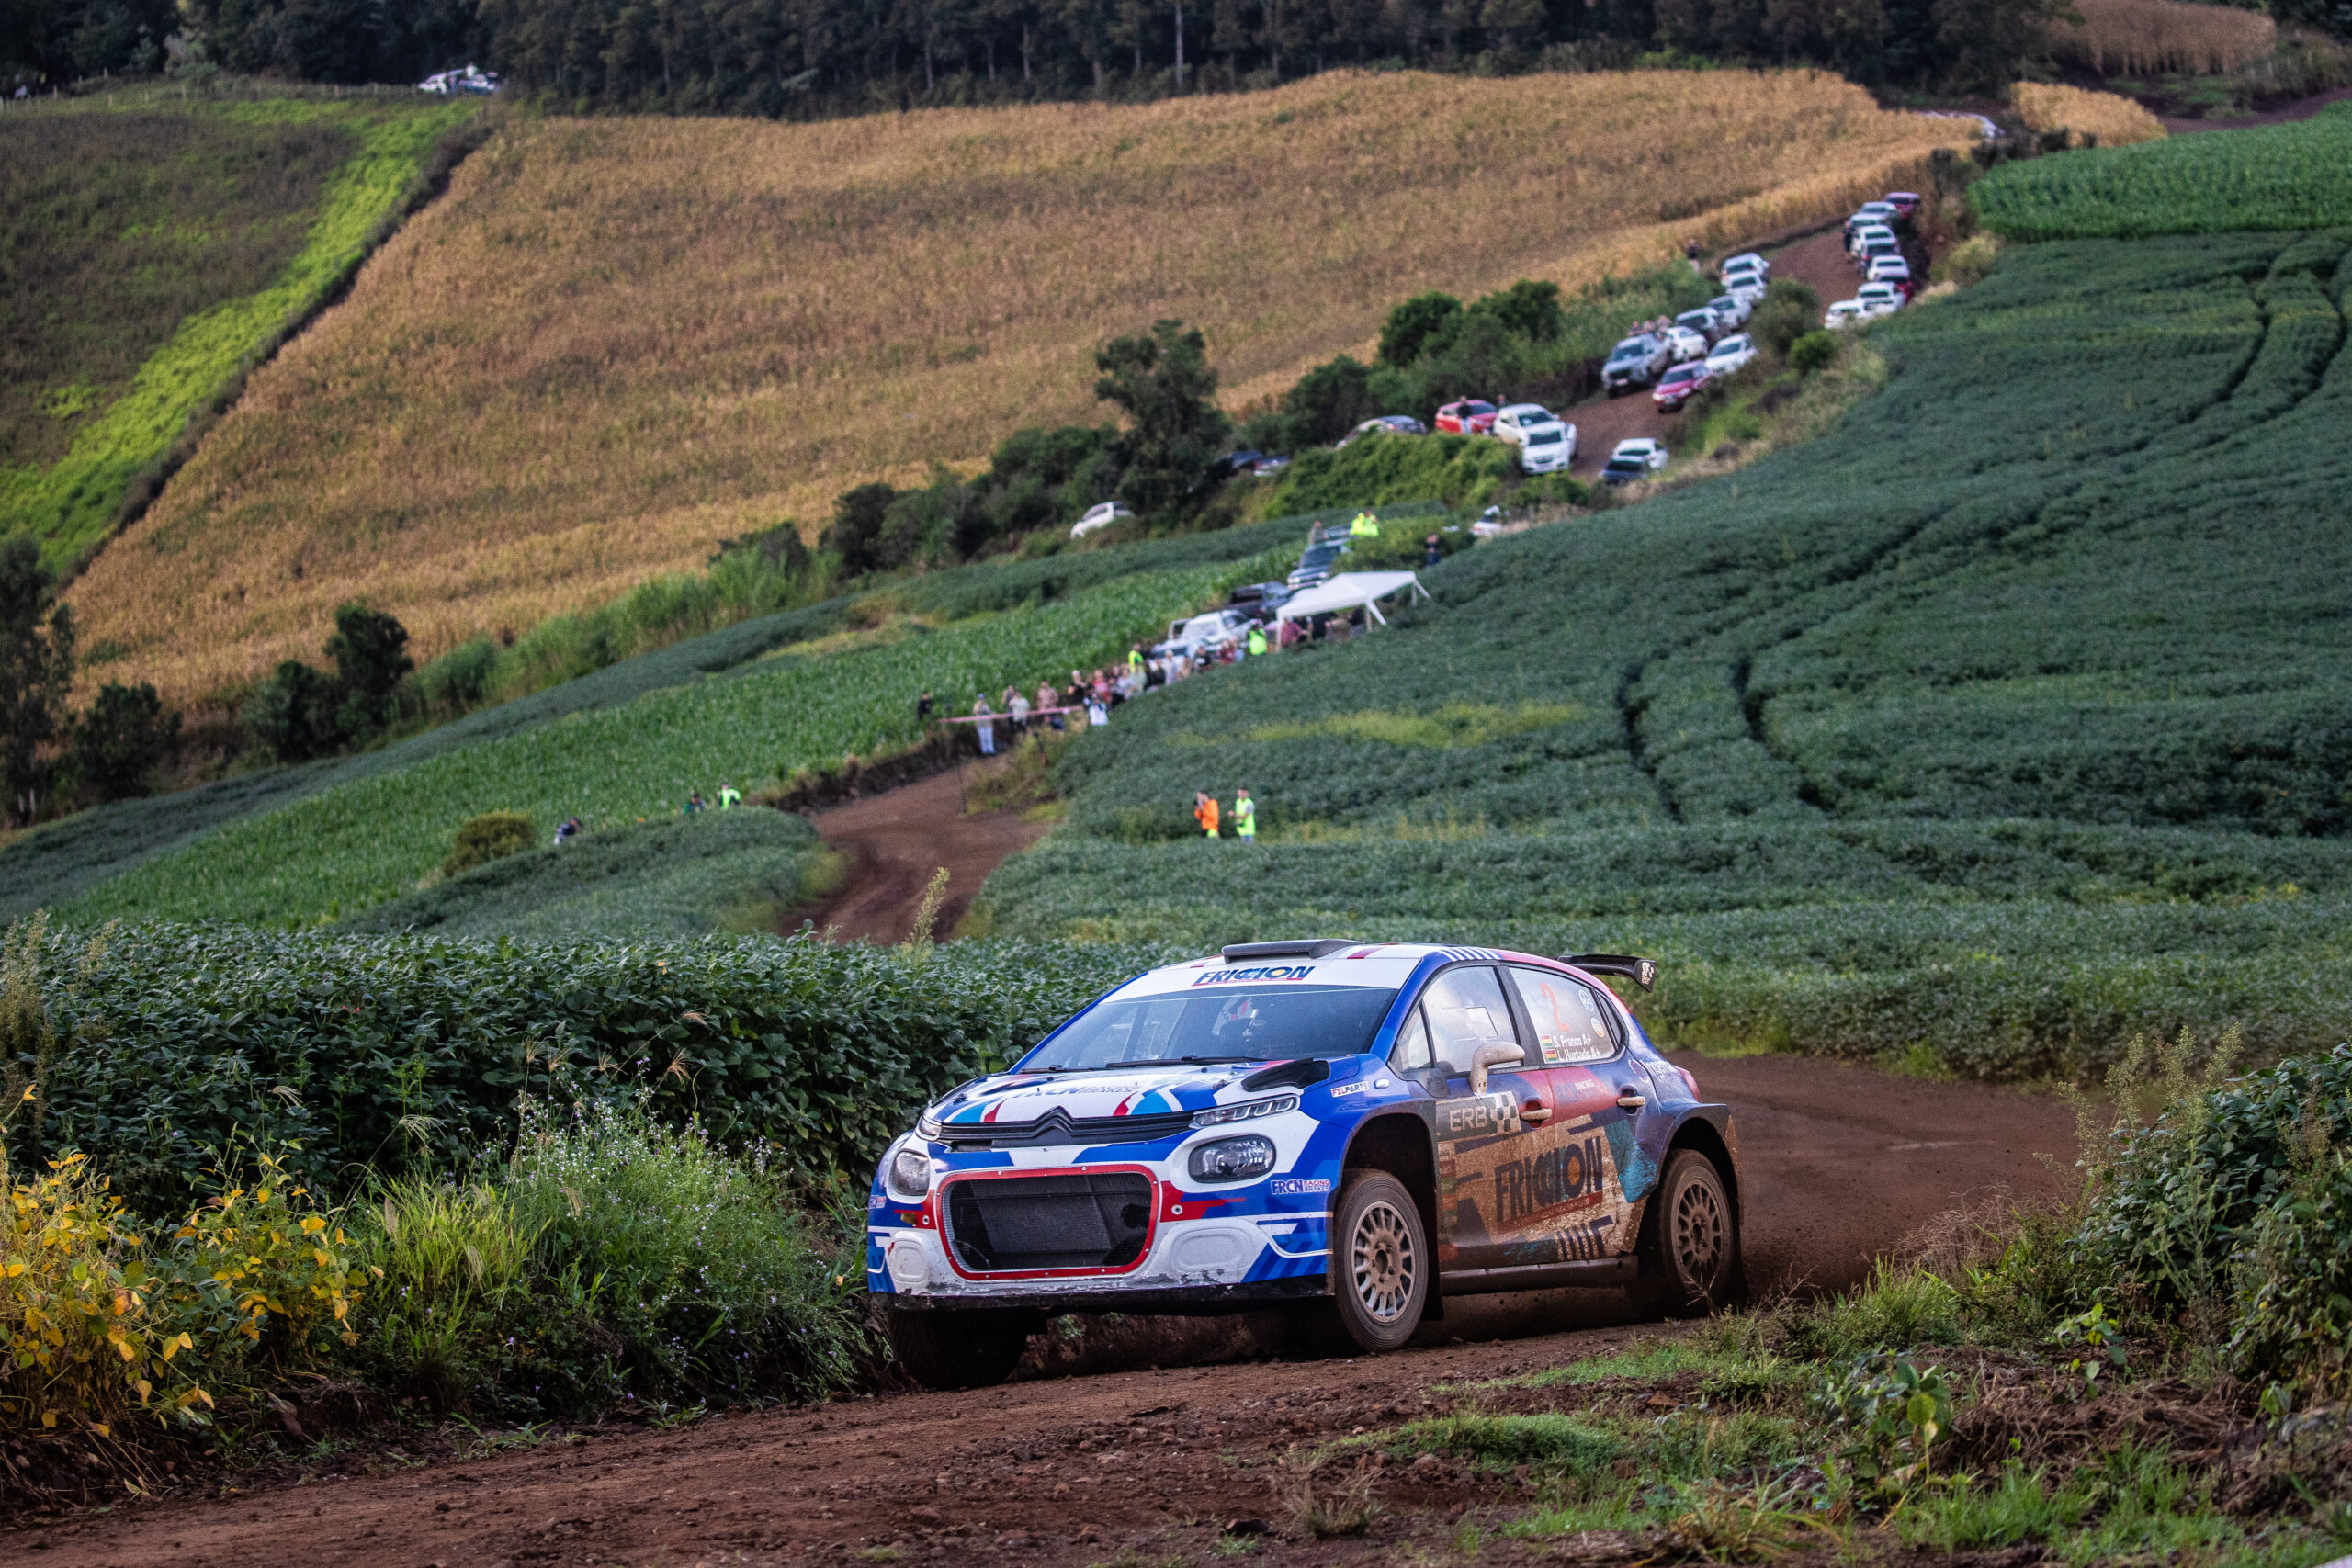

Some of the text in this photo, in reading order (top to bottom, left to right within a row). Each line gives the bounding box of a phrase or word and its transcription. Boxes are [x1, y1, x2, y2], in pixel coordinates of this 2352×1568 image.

[1540, 982, 1570, 1032] 2
[1560, 1035, 1582, 1047] Franco
[1331, 1082, 1369, 1097] FILPARTS
[1449, 1105, 1487, 1132] ERB
[1272, 1179, 1303, 1194] FRCN
